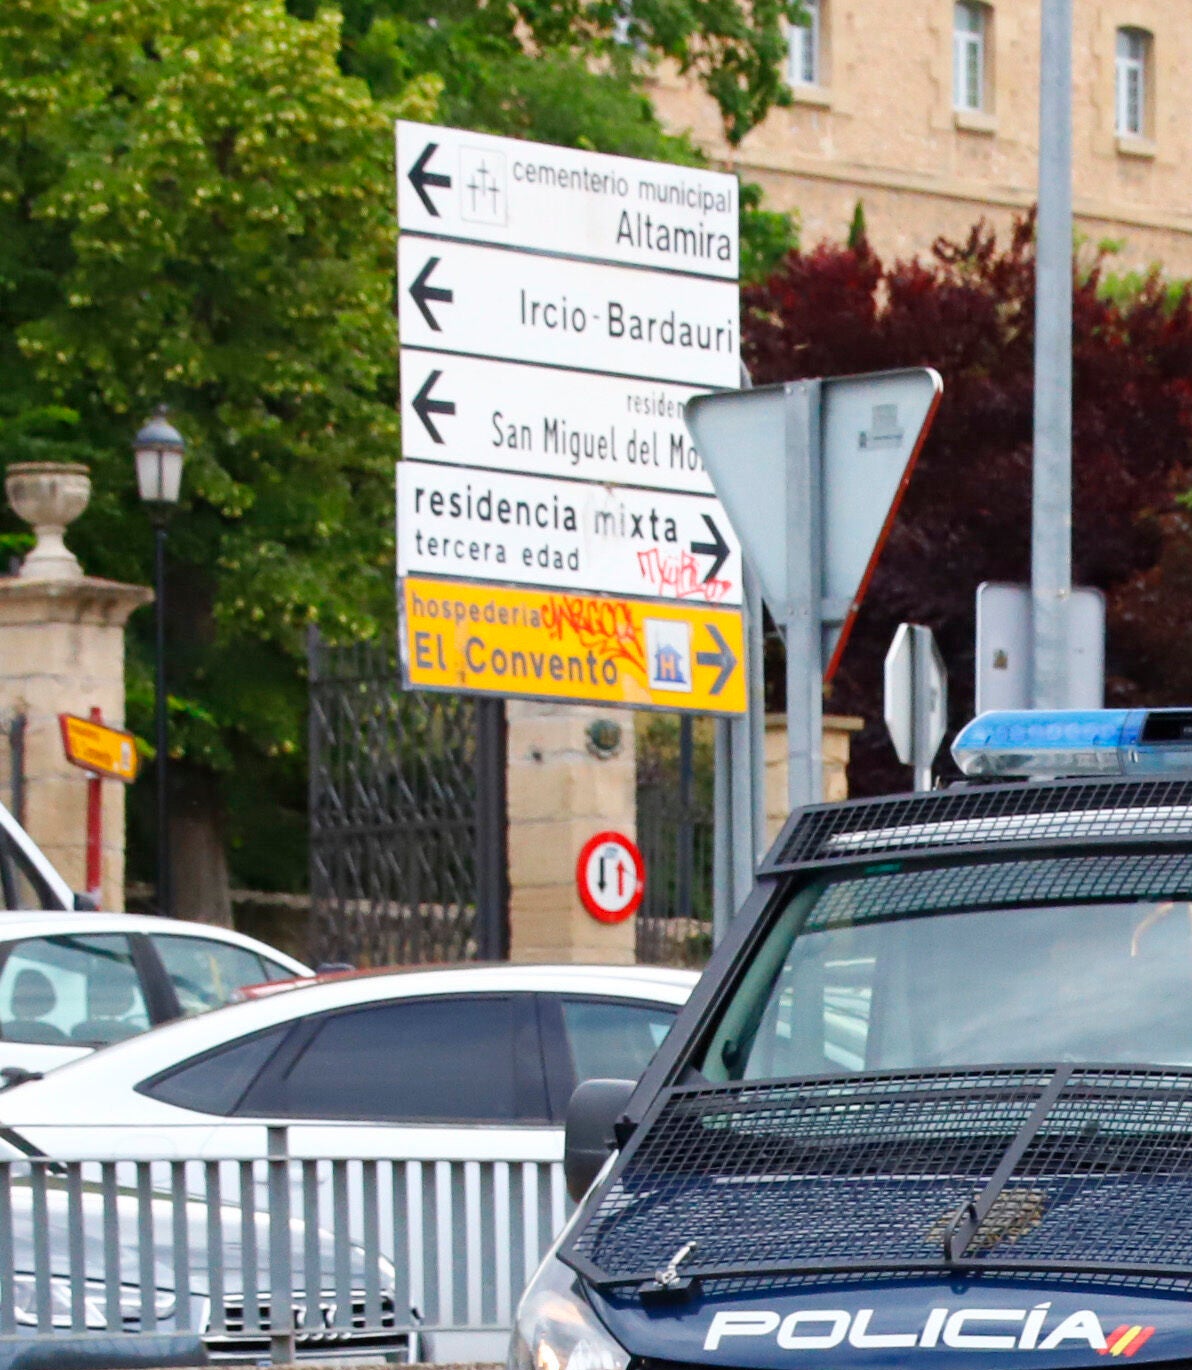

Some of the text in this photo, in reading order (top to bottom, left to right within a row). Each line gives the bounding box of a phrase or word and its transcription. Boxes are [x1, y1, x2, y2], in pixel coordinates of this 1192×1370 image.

[512, 160, 732, 216] cementerio municipal
[616, 209, 733, 262] Altamira
[492, 410, 708, 472] San Miguel del Mo
[414, 484, 679, 543] residencia mixta
[415, 528, 580, 571] tercera edad
[414, 630, 618, 686] El Convento
[703, 1302, 1108, 1351] POLICÍA
